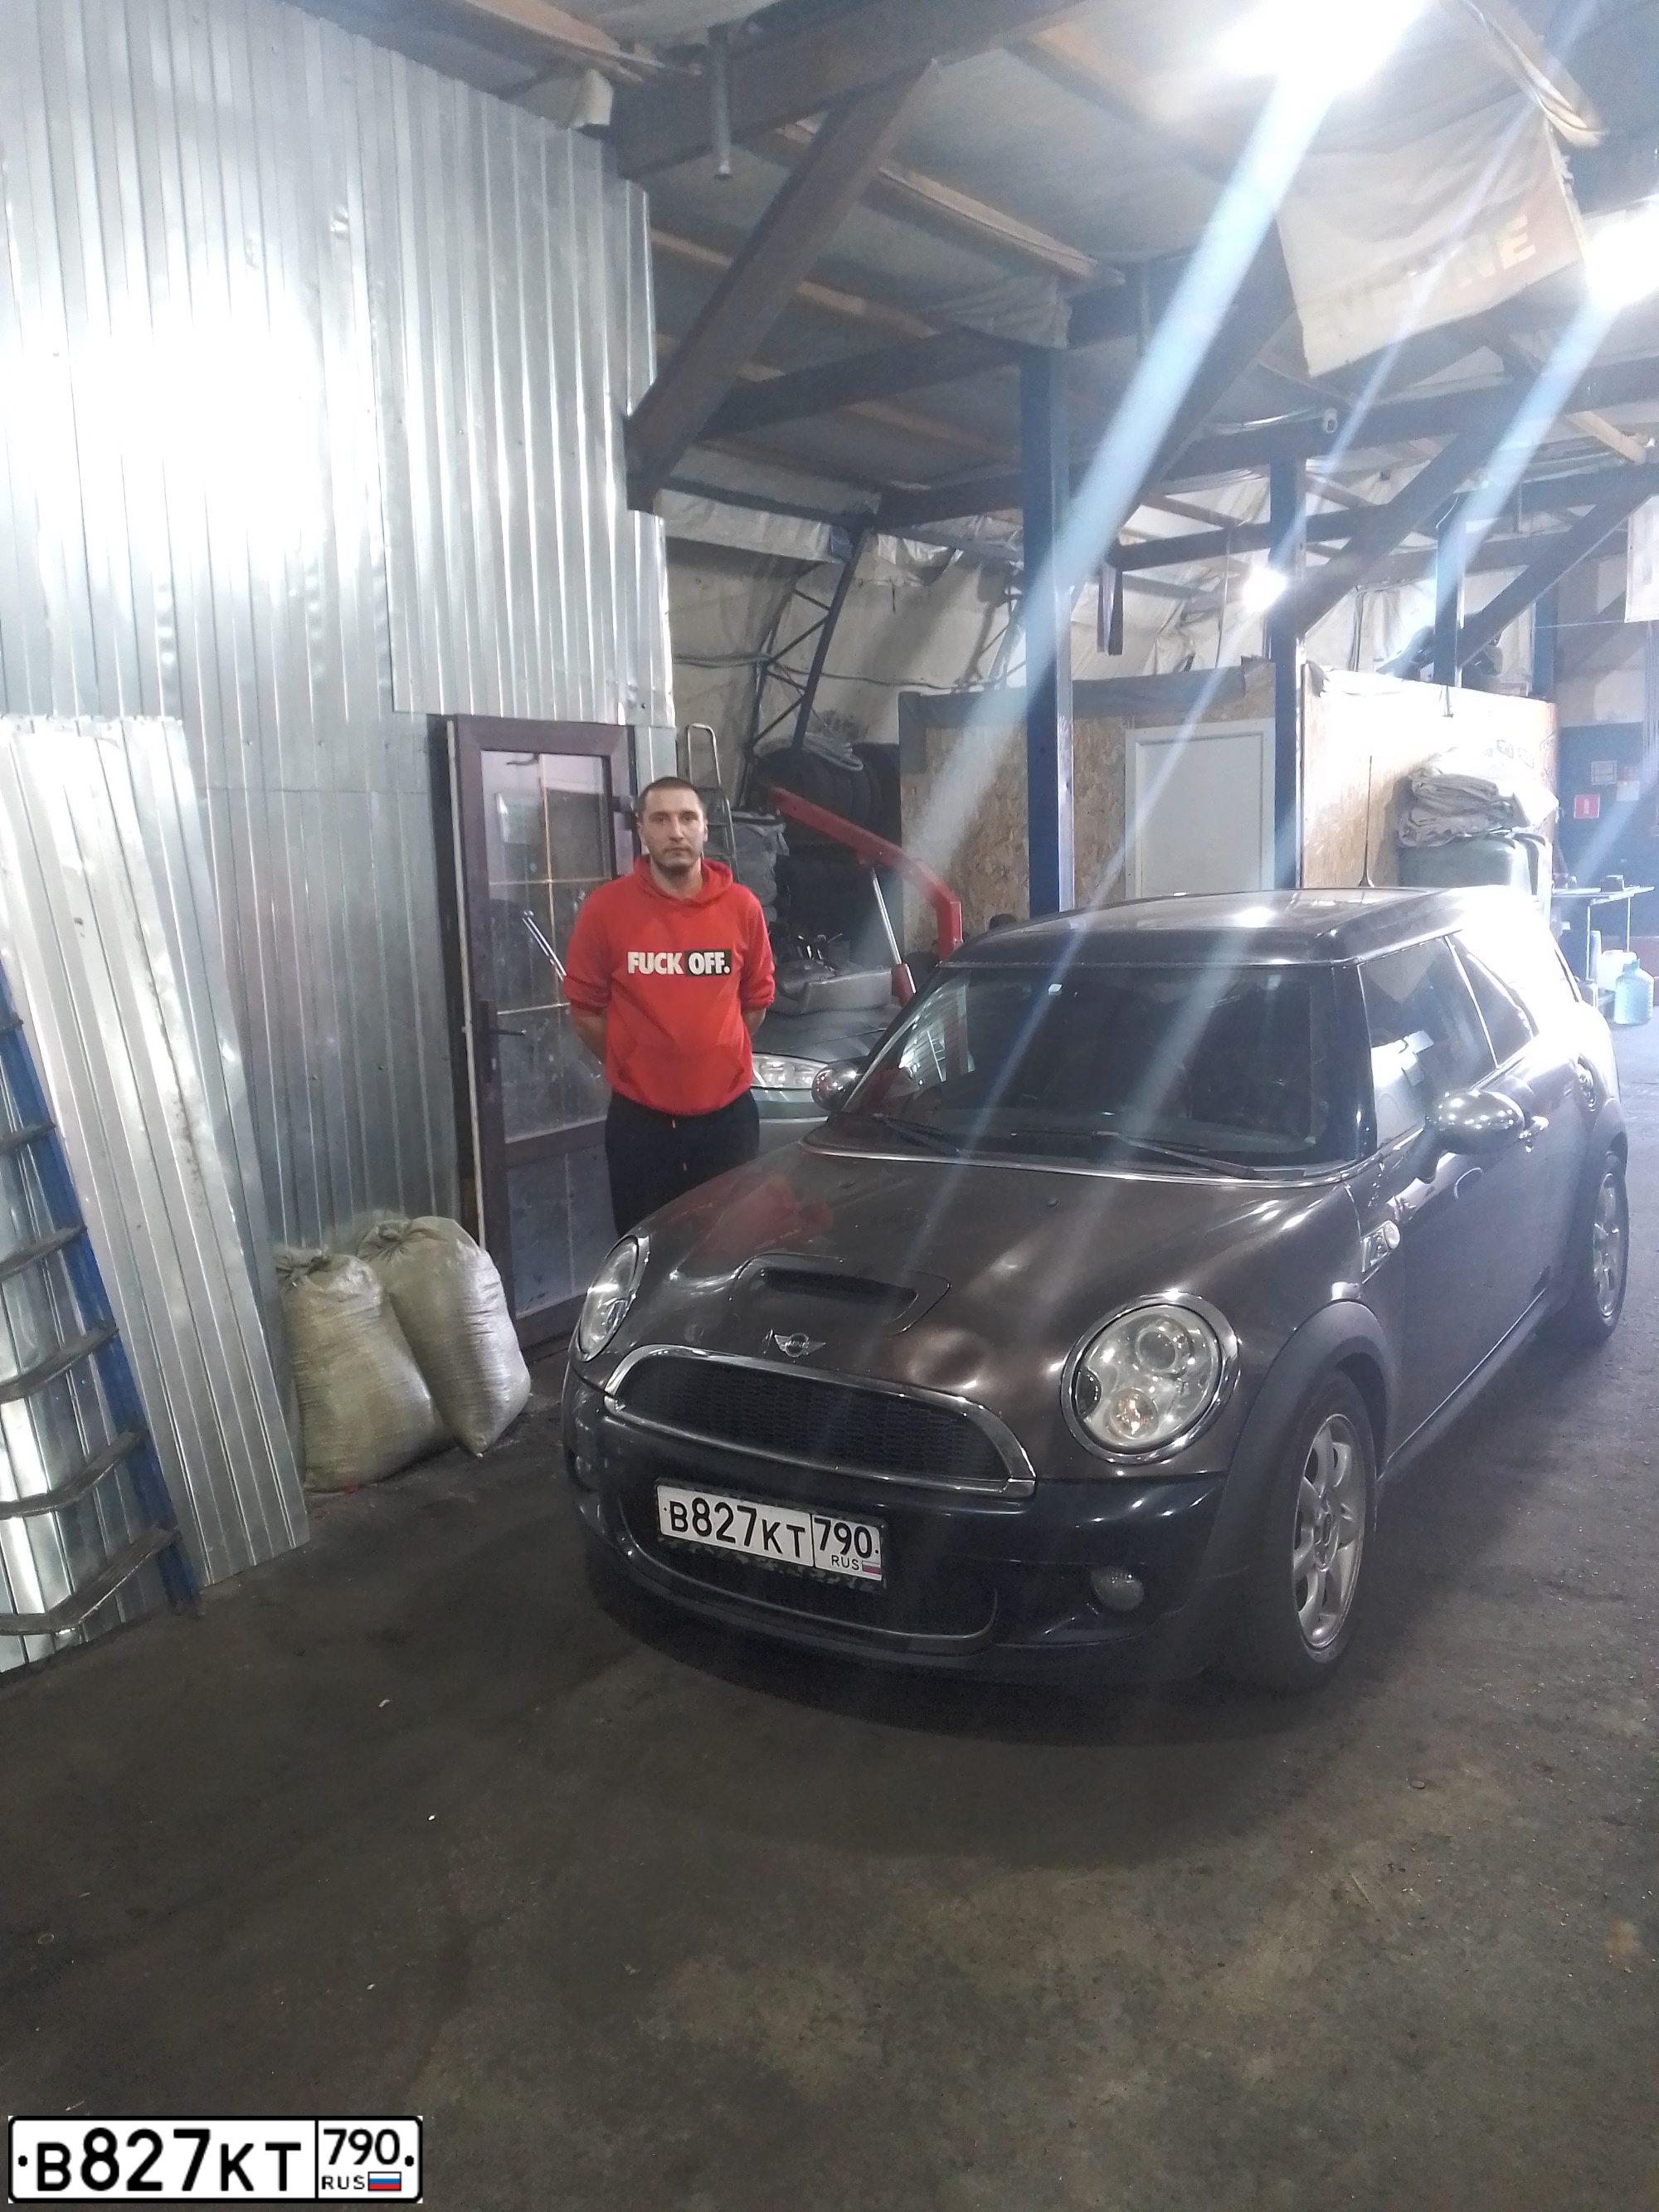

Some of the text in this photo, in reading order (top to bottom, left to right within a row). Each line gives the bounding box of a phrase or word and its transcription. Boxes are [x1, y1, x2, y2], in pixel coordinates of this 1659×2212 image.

[627, 951, 731, 976] FUCK OFF.
[785, 1340, 810, 1348] MINI
[669, 1497, 873, 1558] В827КТ 790
[831, 1554, 860, 1571] RUS
